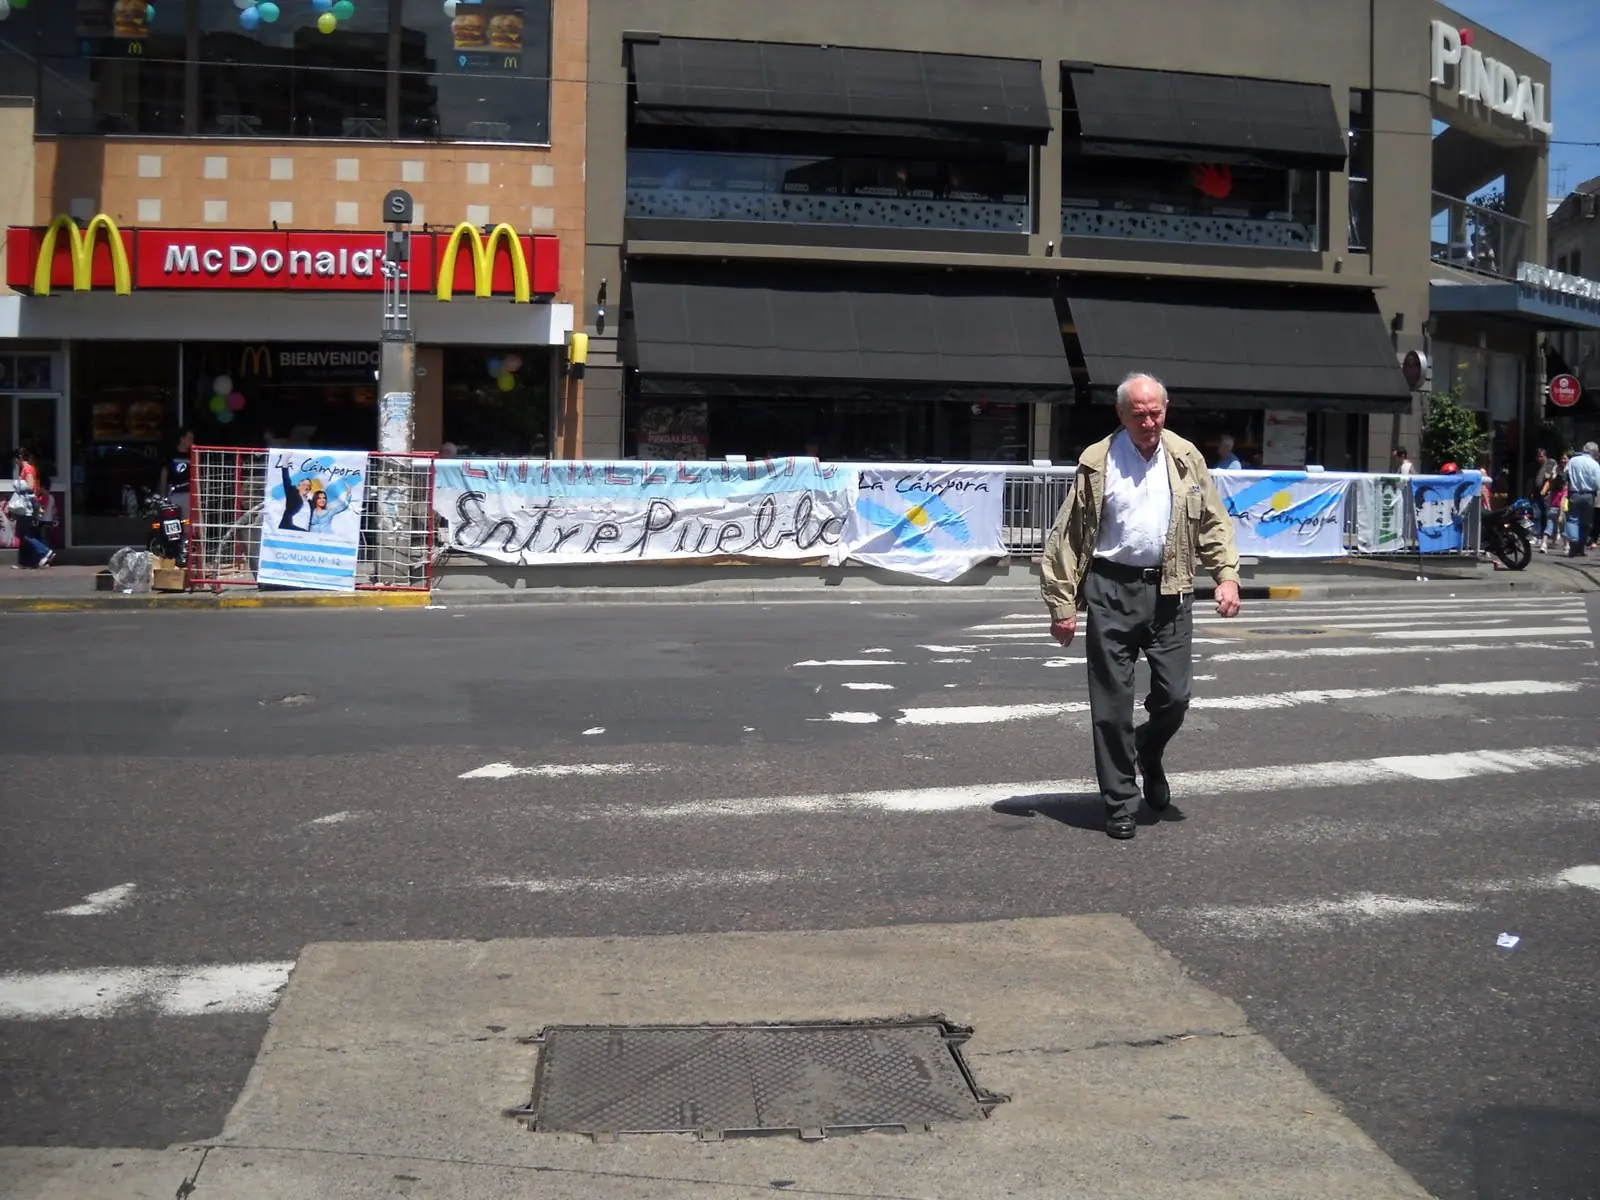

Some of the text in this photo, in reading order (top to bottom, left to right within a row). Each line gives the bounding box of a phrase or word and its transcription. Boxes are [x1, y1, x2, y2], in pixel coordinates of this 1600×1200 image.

[391, 196, 406, 213] S
[275, 453, 294, 470] La
[858, 471, 885, 491] La
[1228, 496, 1250, 521] La
[452, 490, 623, 554] Entre
[275, 551, 316, 563] COMUNA
[332, 557, 341, 566] 12
